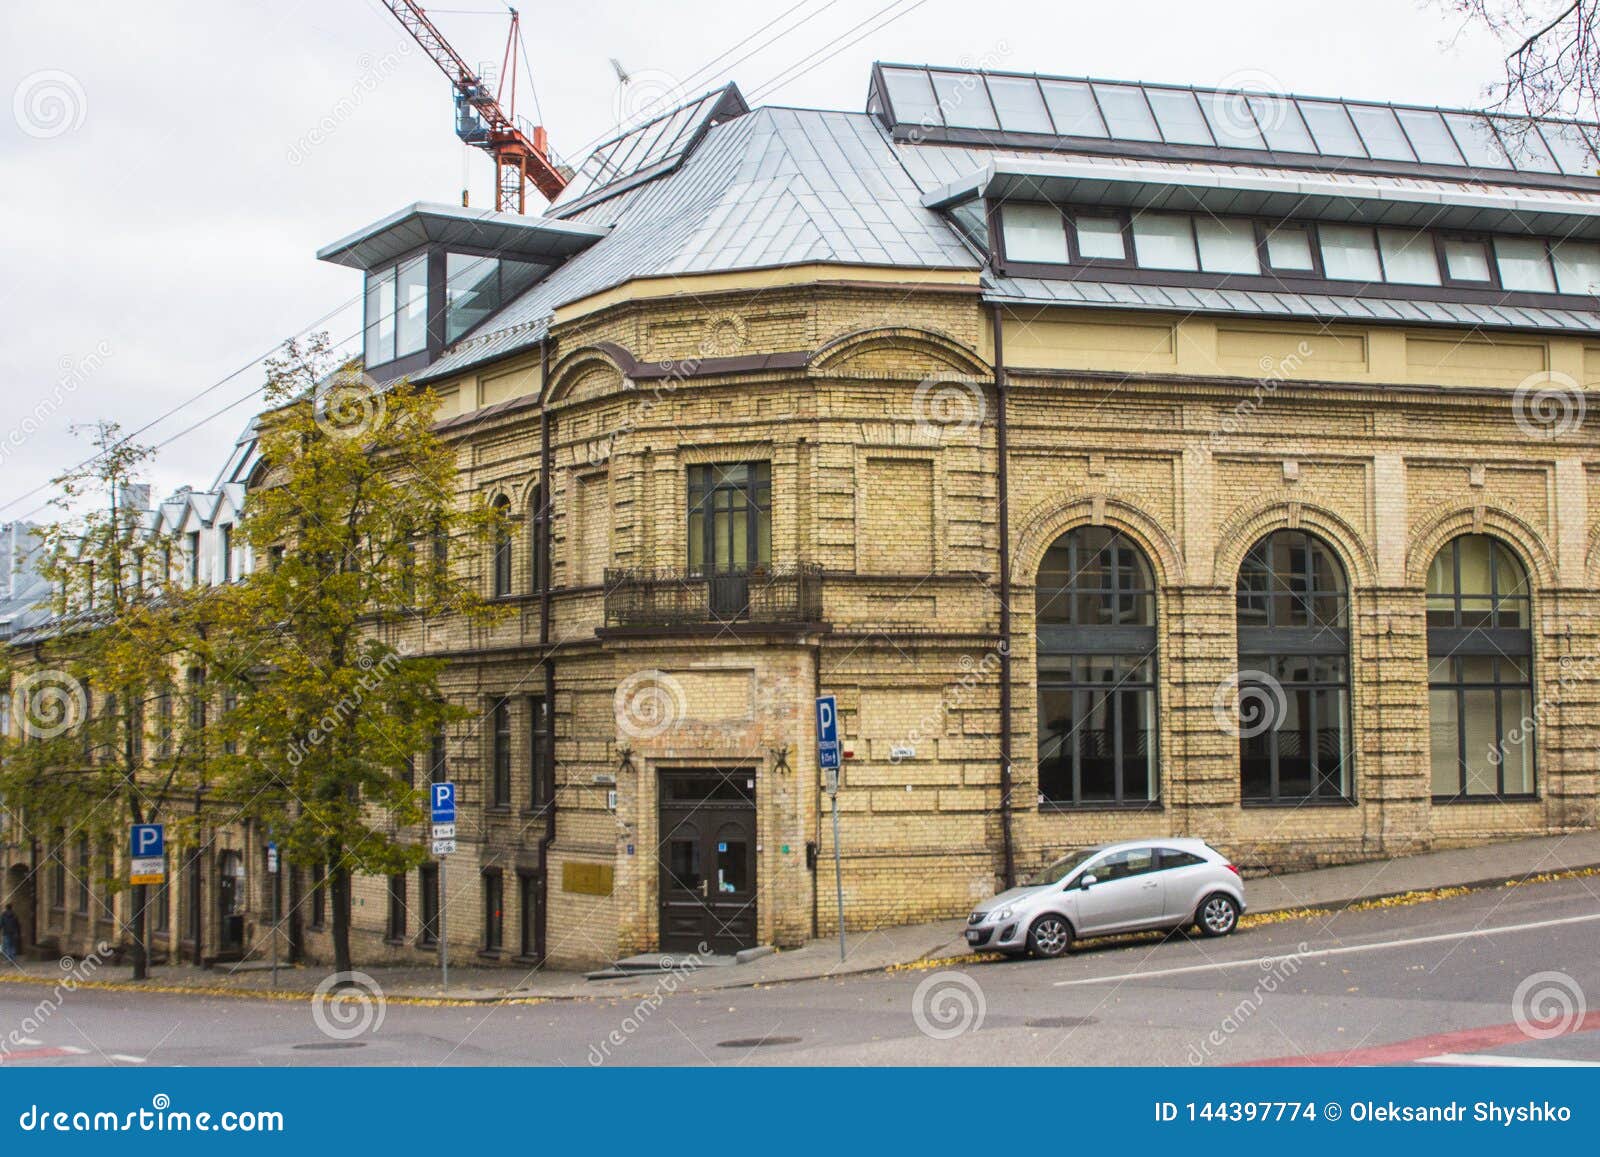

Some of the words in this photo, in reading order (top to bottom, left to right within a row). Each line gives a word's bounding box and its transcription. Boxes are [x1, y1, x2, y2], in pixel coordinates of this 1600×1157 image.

[820, 702, 832, 740] P
[436, 786, 450, 807] P
[139, 828, 158, 854] P
